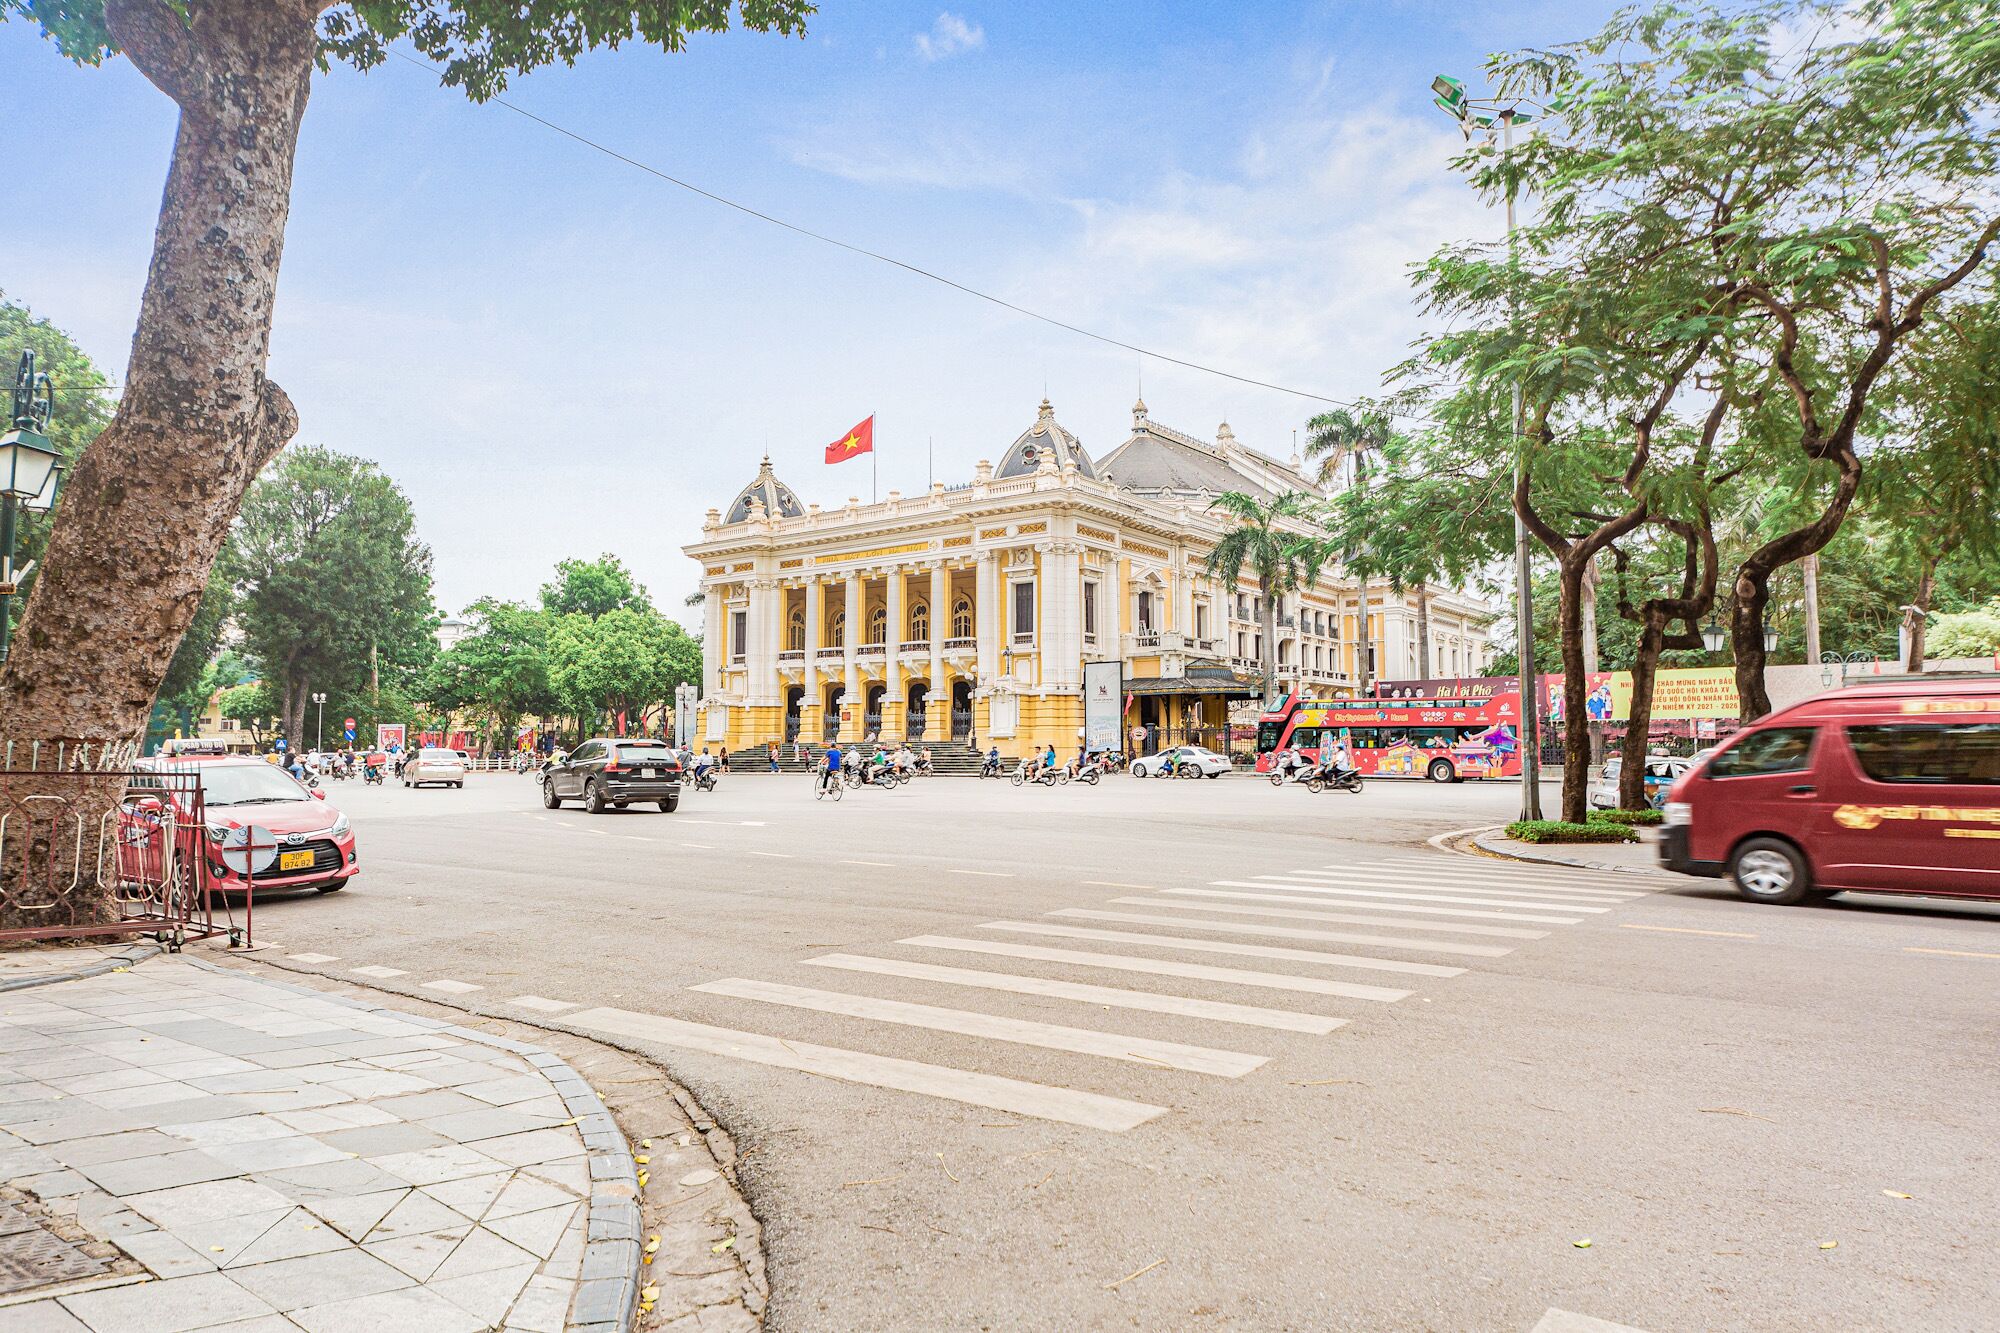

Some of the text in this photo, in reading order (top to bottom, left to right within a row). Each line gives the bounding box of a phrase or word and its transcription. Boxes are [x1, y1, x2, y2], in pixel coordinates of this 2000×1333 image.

[1666, 687, 1685, 695] QUỐC
[1686, 686, 1698, 696] HỘI
[1669, 695, 1681, 704] HỘI
[1703, 694, 1722, 702] NHÂN
[1662, 703, 1685, 711] NHIỆM
[290, 852, 305, 861] 30F
